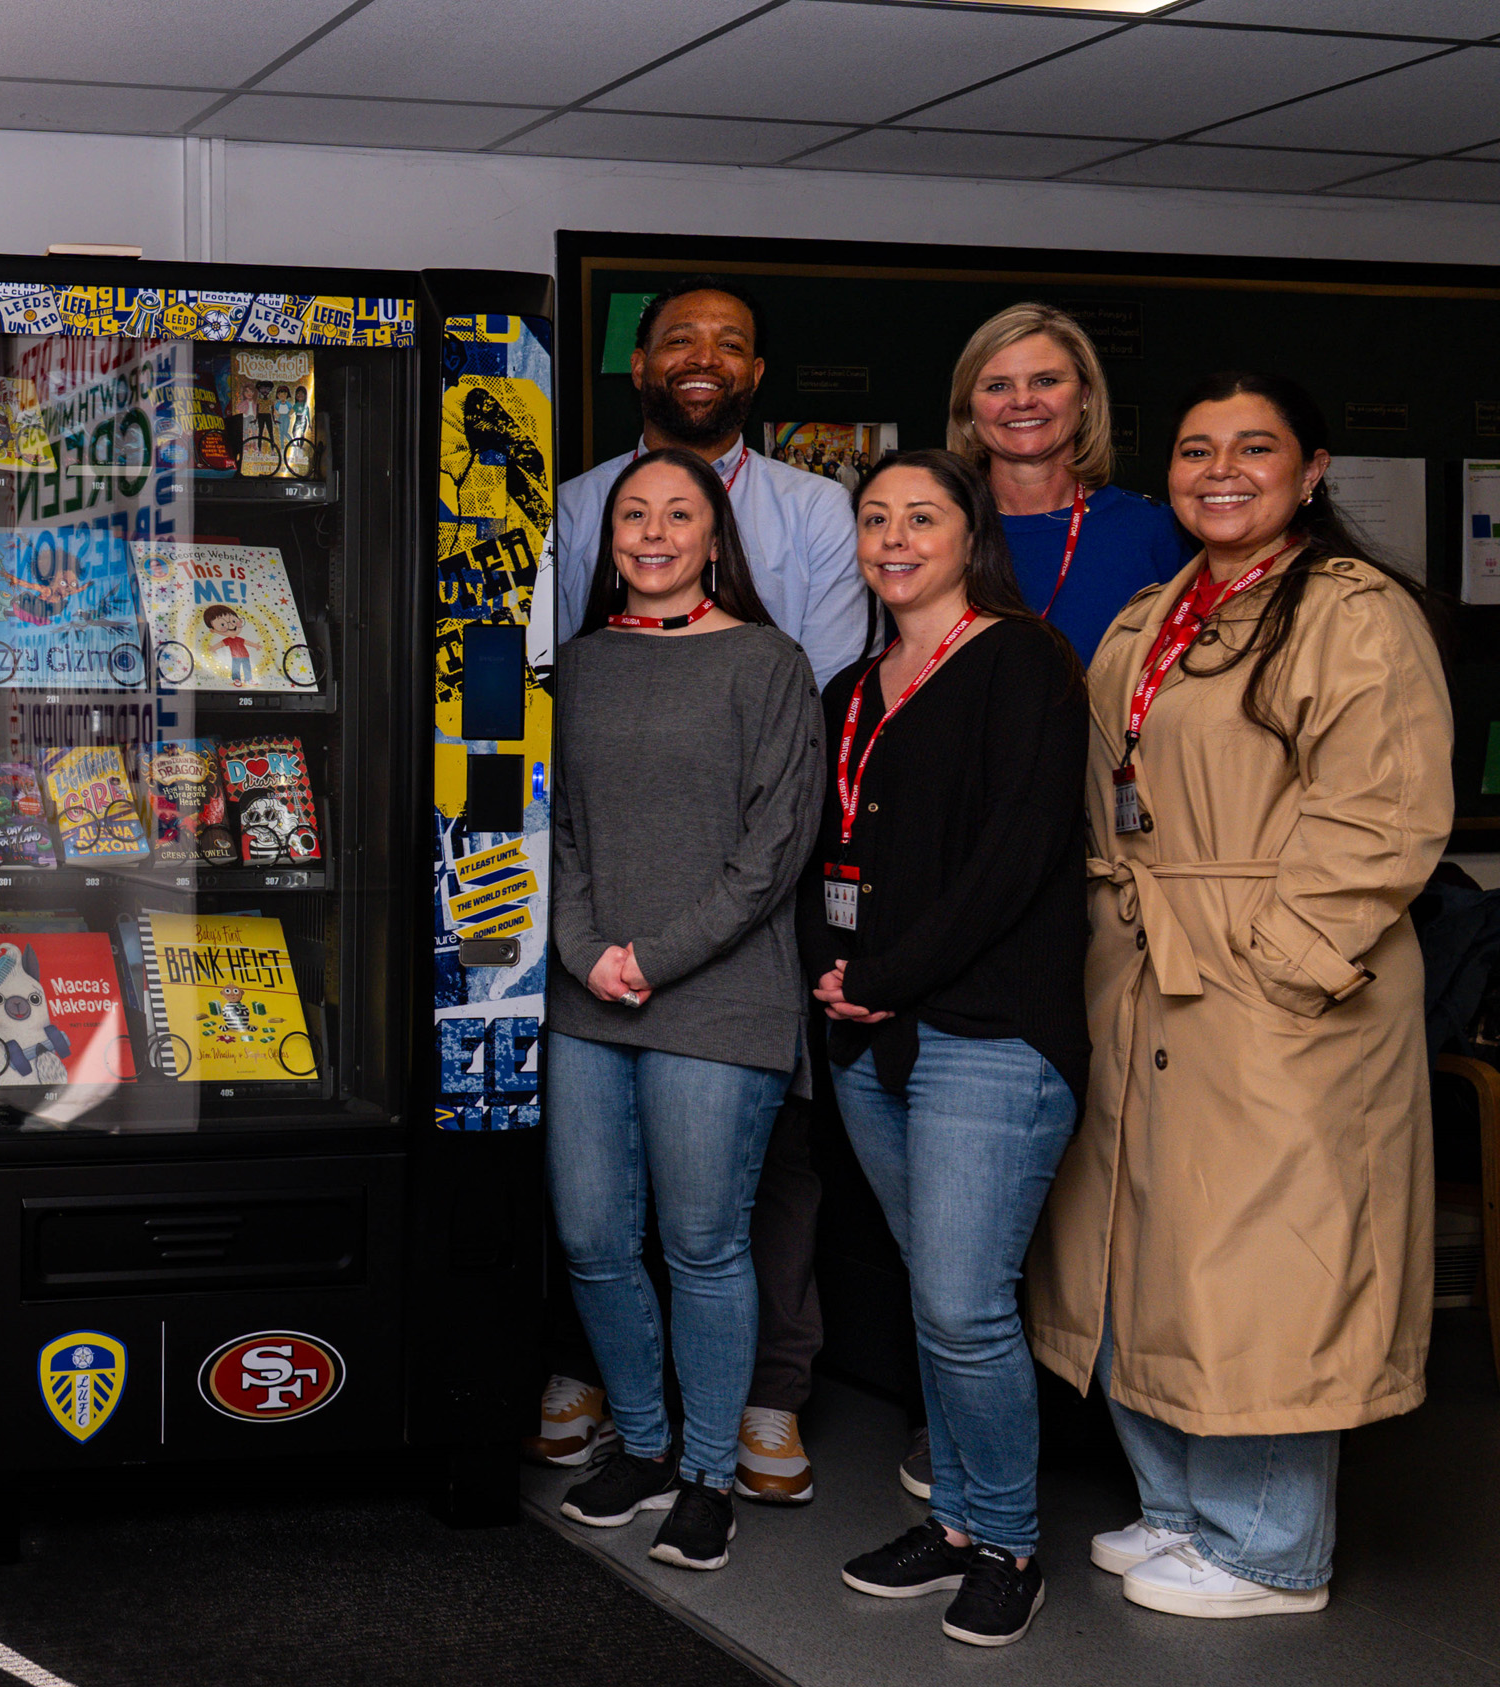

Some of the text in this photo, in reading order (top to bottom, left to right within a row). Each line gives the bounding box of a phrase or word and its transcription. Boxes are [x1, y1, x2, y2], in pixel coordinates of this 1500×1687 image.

[4, 297, 51, 316] LEEDS
[313, 305, 352, 329] LEEDS
[8, 313, 58, 334] UNITED
[166, 313, 196, 326] LEEDS
[255, 309, 299, 335] LEEDS
[237, 353, 308, 377] Rose Gold
[165, 387, 186, 402] GYM
[185, 387, 216, 403] TEACHER
[173, 401, 202, 415] IS AN
[92, 481, 105, 490] 103
[171, 485, 183, 493] 105
[285, 488, 298, 496] 107
[1070, 512, 1080, 537] VISITOR
[169, 550, 251, 565] George Webster
[178, 559, 246, 580] This is
[1232, 568, 1263, 592] VISITOR
[194, 580, 247, 604] ME!
[1173, 601, 1191, 625] VISITOR
[943, 620, 969, 645] VISITOR
[47, 644, 136, 672] Gizmo
[1160, 643, 1184, 671] VISITOR
[913, 659, 937, 686] VISITOR
[46, 695, 60, 703] 201
[239, 698, 253, 706] 205
[848, 697, 860, 723] VISITOR
[840, 735, 851, 763] VISITOR
[859, 738, 875, 768] VISITOR
[158, 765, 203, 780] DRAGON
[163, 786, 177, 795] How
[185, 783, 207, 792] Break
[839, 778, 849, 809] VISITOR
[848, 784, 858, 816] VISITOR
[7, 825, 23, 835] DAY
[76, 839, 140, 855] DIXON
[460, 848, 519, 876] AT LEAST UNTIL
[0, 878, 12, 886] 301
[86, 878, 100, 886] 303
[176, 877, 190, 886] 305
[265, 877, 279, 886] 307
[457, 880, 527, 912] THE WORLD STOPS
[195, 924, 243, 949] Baby's First
[473, 915, 525, 939] GOING ROUND
[164, 946, 284, 988] BANK HEIST
[50, 977, 110, 996] Macca's
[49, 998, 119, 1017] Makeover
[44, 1092, 58, 1101] 401
[220, 1089, 234, 1097] 405
[241, 1345, 317, 1409] SF
[77, 1375, 89, 1426] LUFC
